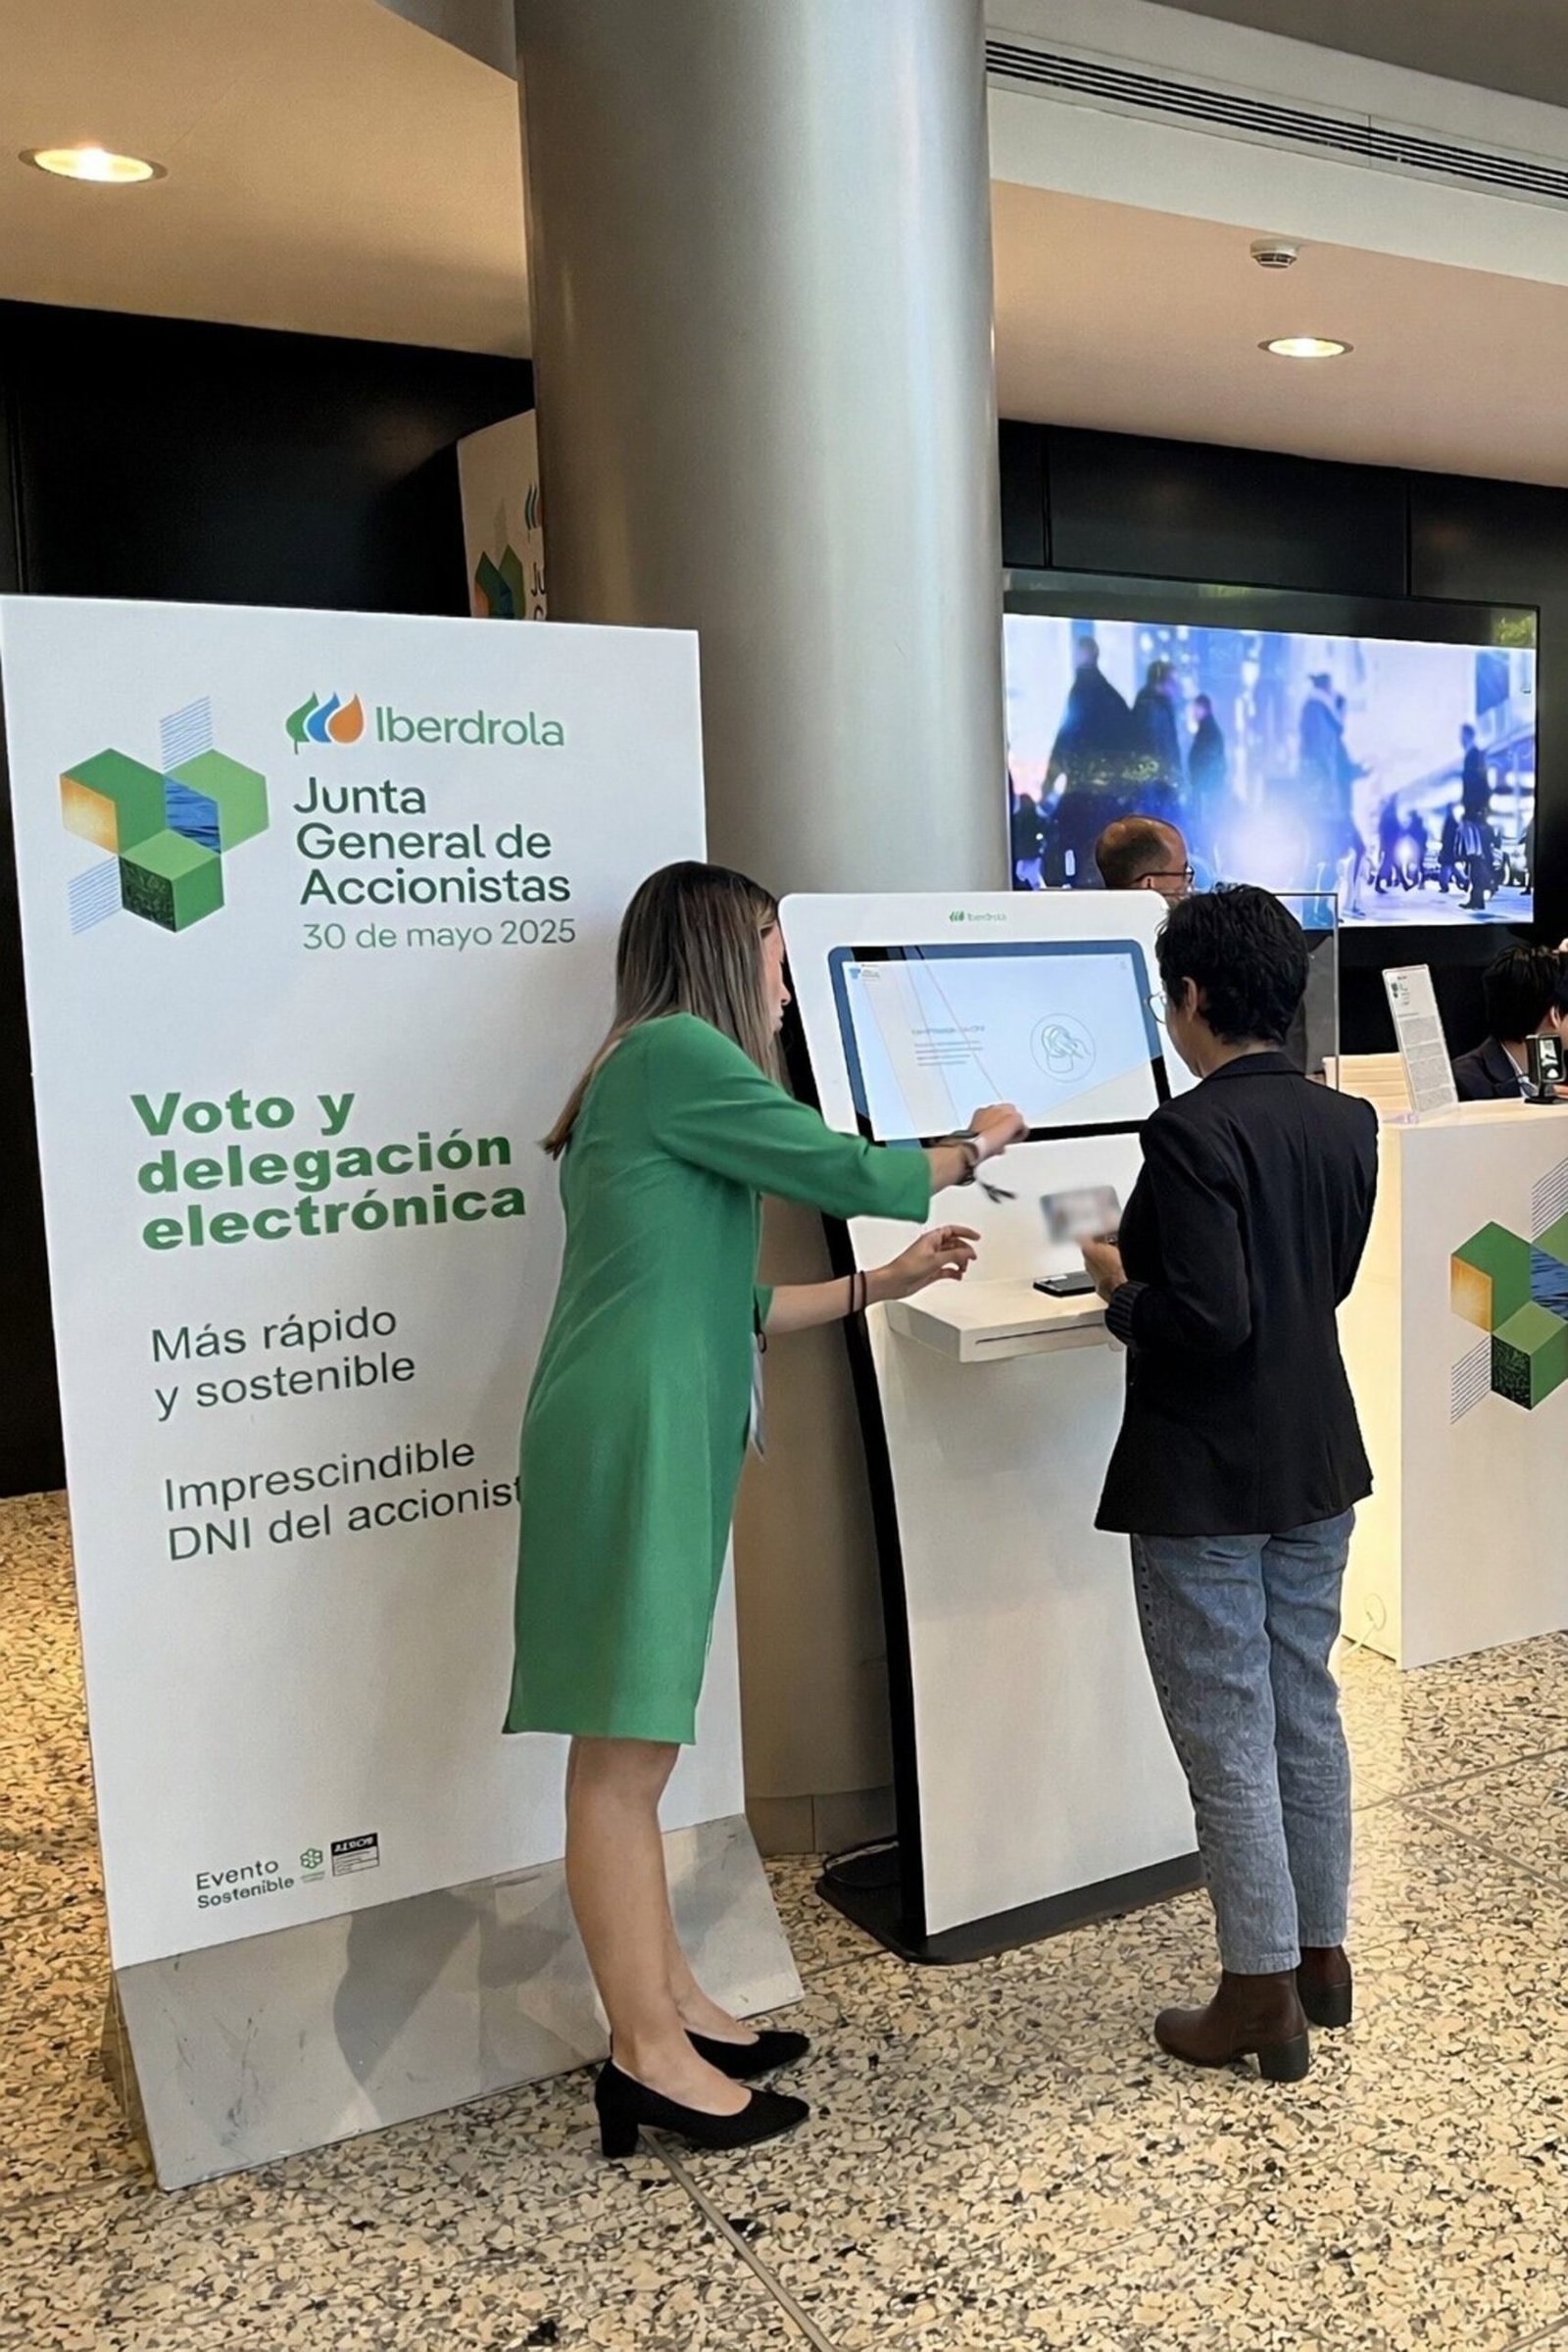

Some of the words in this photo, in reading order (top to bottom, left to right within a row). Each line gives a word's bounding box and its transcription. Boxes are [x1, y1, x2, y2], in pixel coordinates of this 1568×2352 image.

[375, 706, 565, 746] Iberdrola
[293, 777, 426, 814] Junta
[296, 822, 486, 860] General
[495, 823, 552, 859] de
[300, 866, 571, 906] Accionistas
[303, 923, 346, 951] 30
[355, 923, 398, 949] de
[407, 927, 493, 953] mayo
[500, 918, 576, 945] 2025
[130, 1089, 295, 1137] Voto
[317, 1092, 356, 1137] y
[137, 1128, 512, 1195] delegación
[142, 1183, 526, 1250] electrónica
[151, 1322, 247, 1363] Más
[263, 1305, 397, 1353] rápido
[154, 1386, 179, 1423] y
[196, 1350, 416, 1408] sostenible
[165, 1438, 475, 1512] Imprescindible
[169, 1516, 252, 1562] DNI
[269, 1503, 331, 1544] del
[347, 1476, 521, 1532] accionist
[196, 1859, 279, 1891] Evento
[197, 1876, 295, 1909] Sostenible
